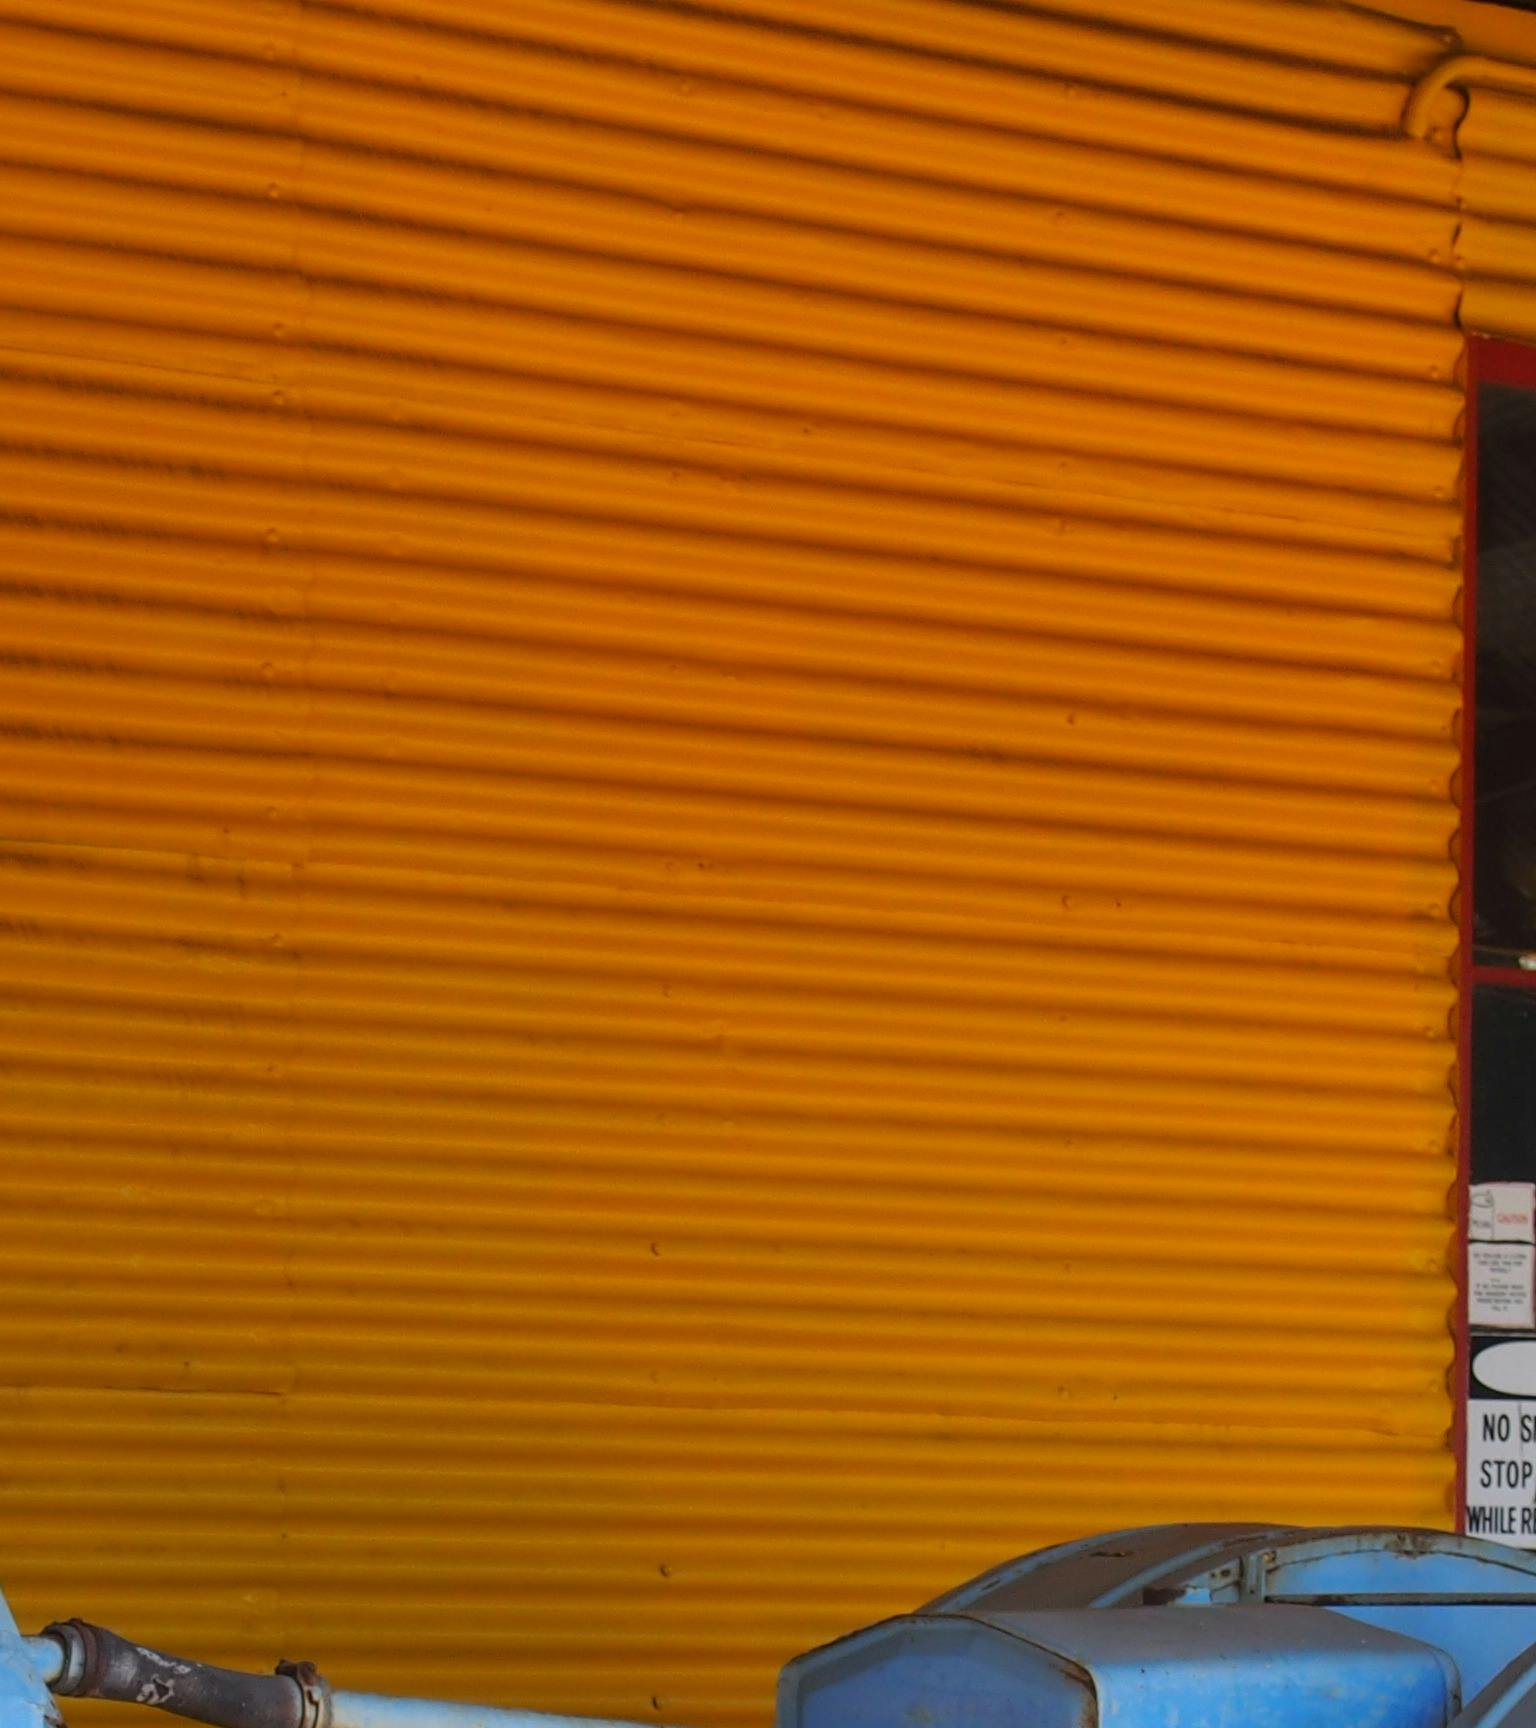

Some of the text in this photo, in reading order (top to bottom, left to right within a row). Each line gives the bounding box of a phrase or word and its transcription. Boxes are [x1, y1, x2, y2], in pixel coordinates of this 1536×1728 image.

[1482, 1413, 1510, 1442] NO
[1480, 1459, 1533, 1489] STOP
[1466, 1505, 1517, 1535] WHILE
